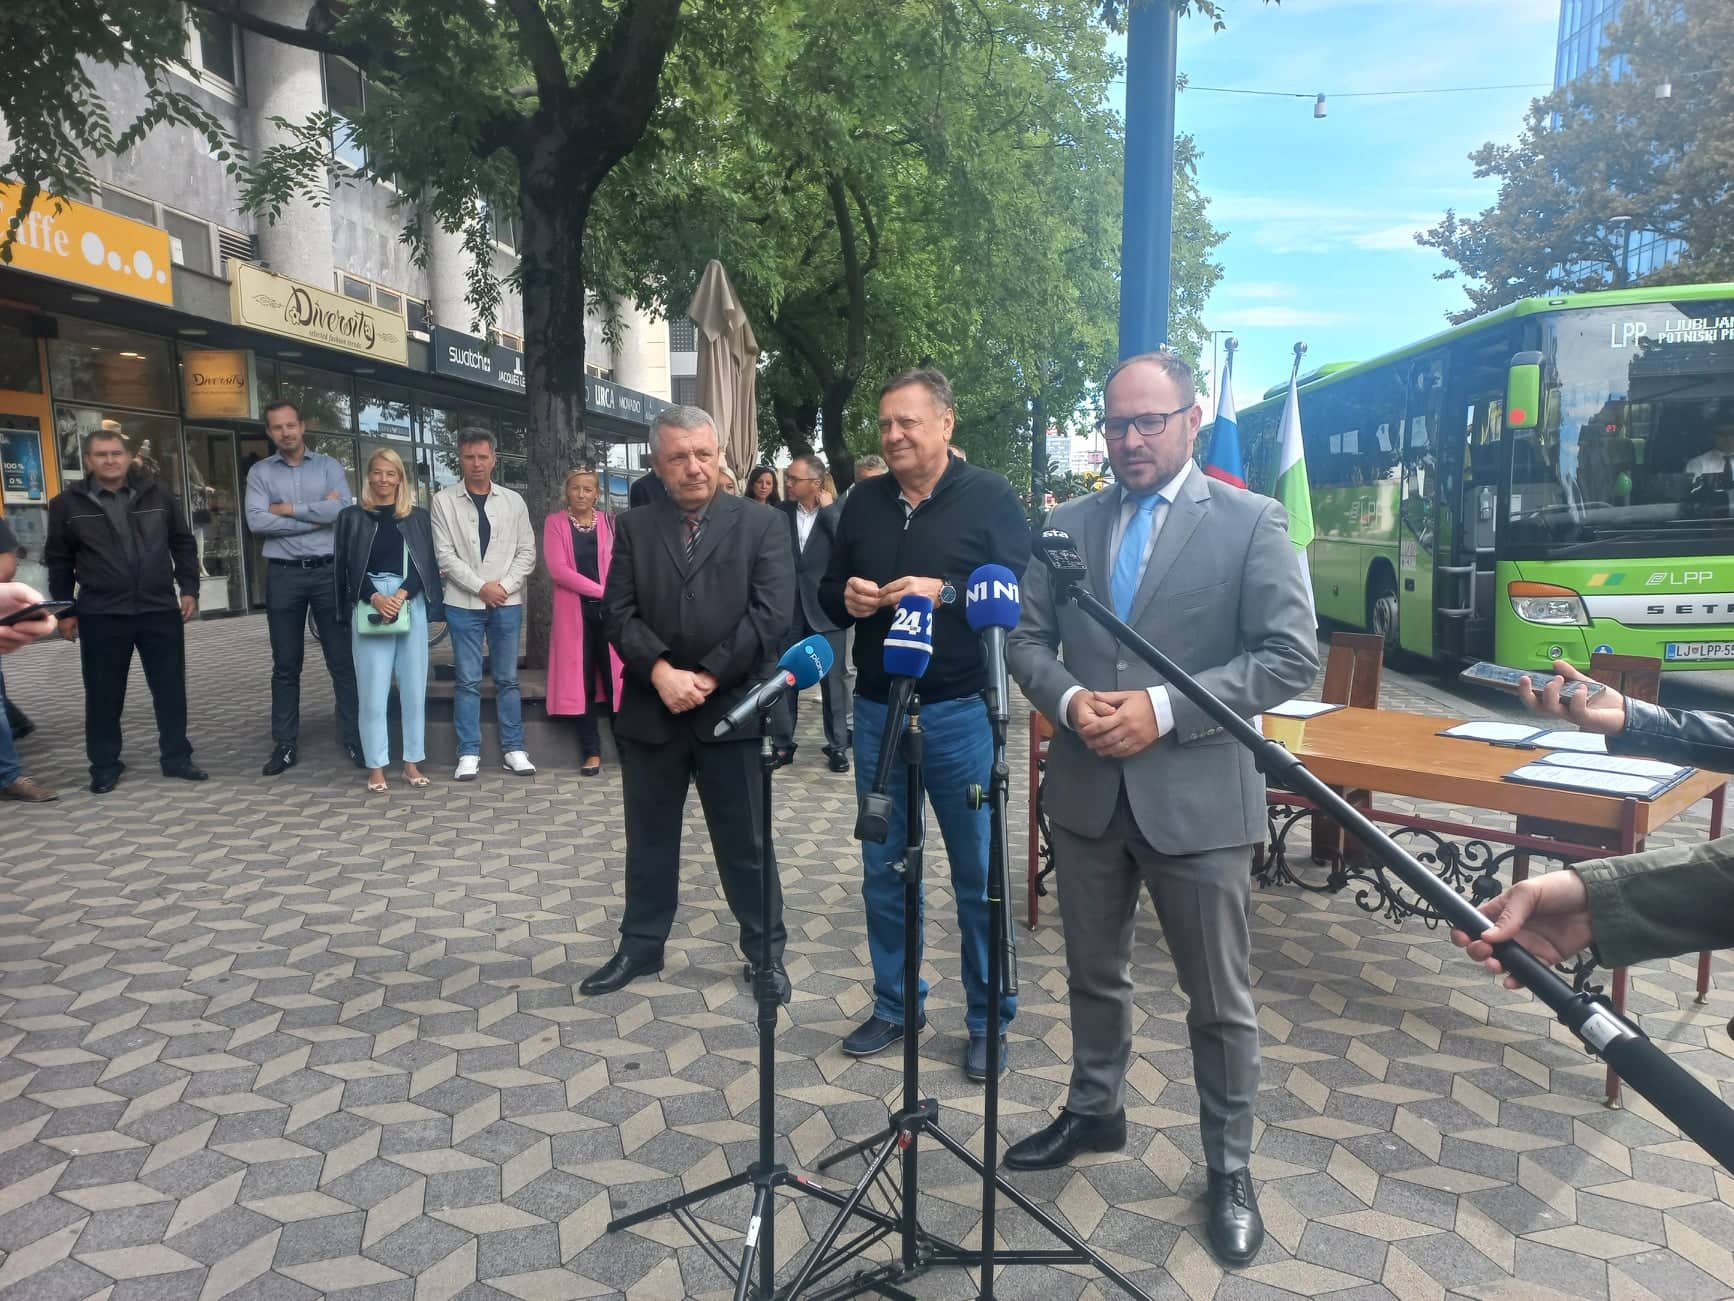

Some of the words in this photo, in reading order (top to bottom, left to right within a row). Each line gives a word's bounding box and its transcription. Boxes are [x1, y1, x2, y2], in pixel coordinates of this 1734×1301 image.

[0, 202, 71, 257] affe
[285, 286, 375, 350] Diversity
[1611, 321, 1647, 348] LPP
[448, 345, 485, 371] swatch
[1042, 529, 1069, 539] sta
[1670, 571, 1713, 585] LPP
[966, 581, 988, 608] N1
[993, 580, 1020, 604] N1
[890, 607, 922, 636] 24
[1676, 645, 1691, 657] LJ
